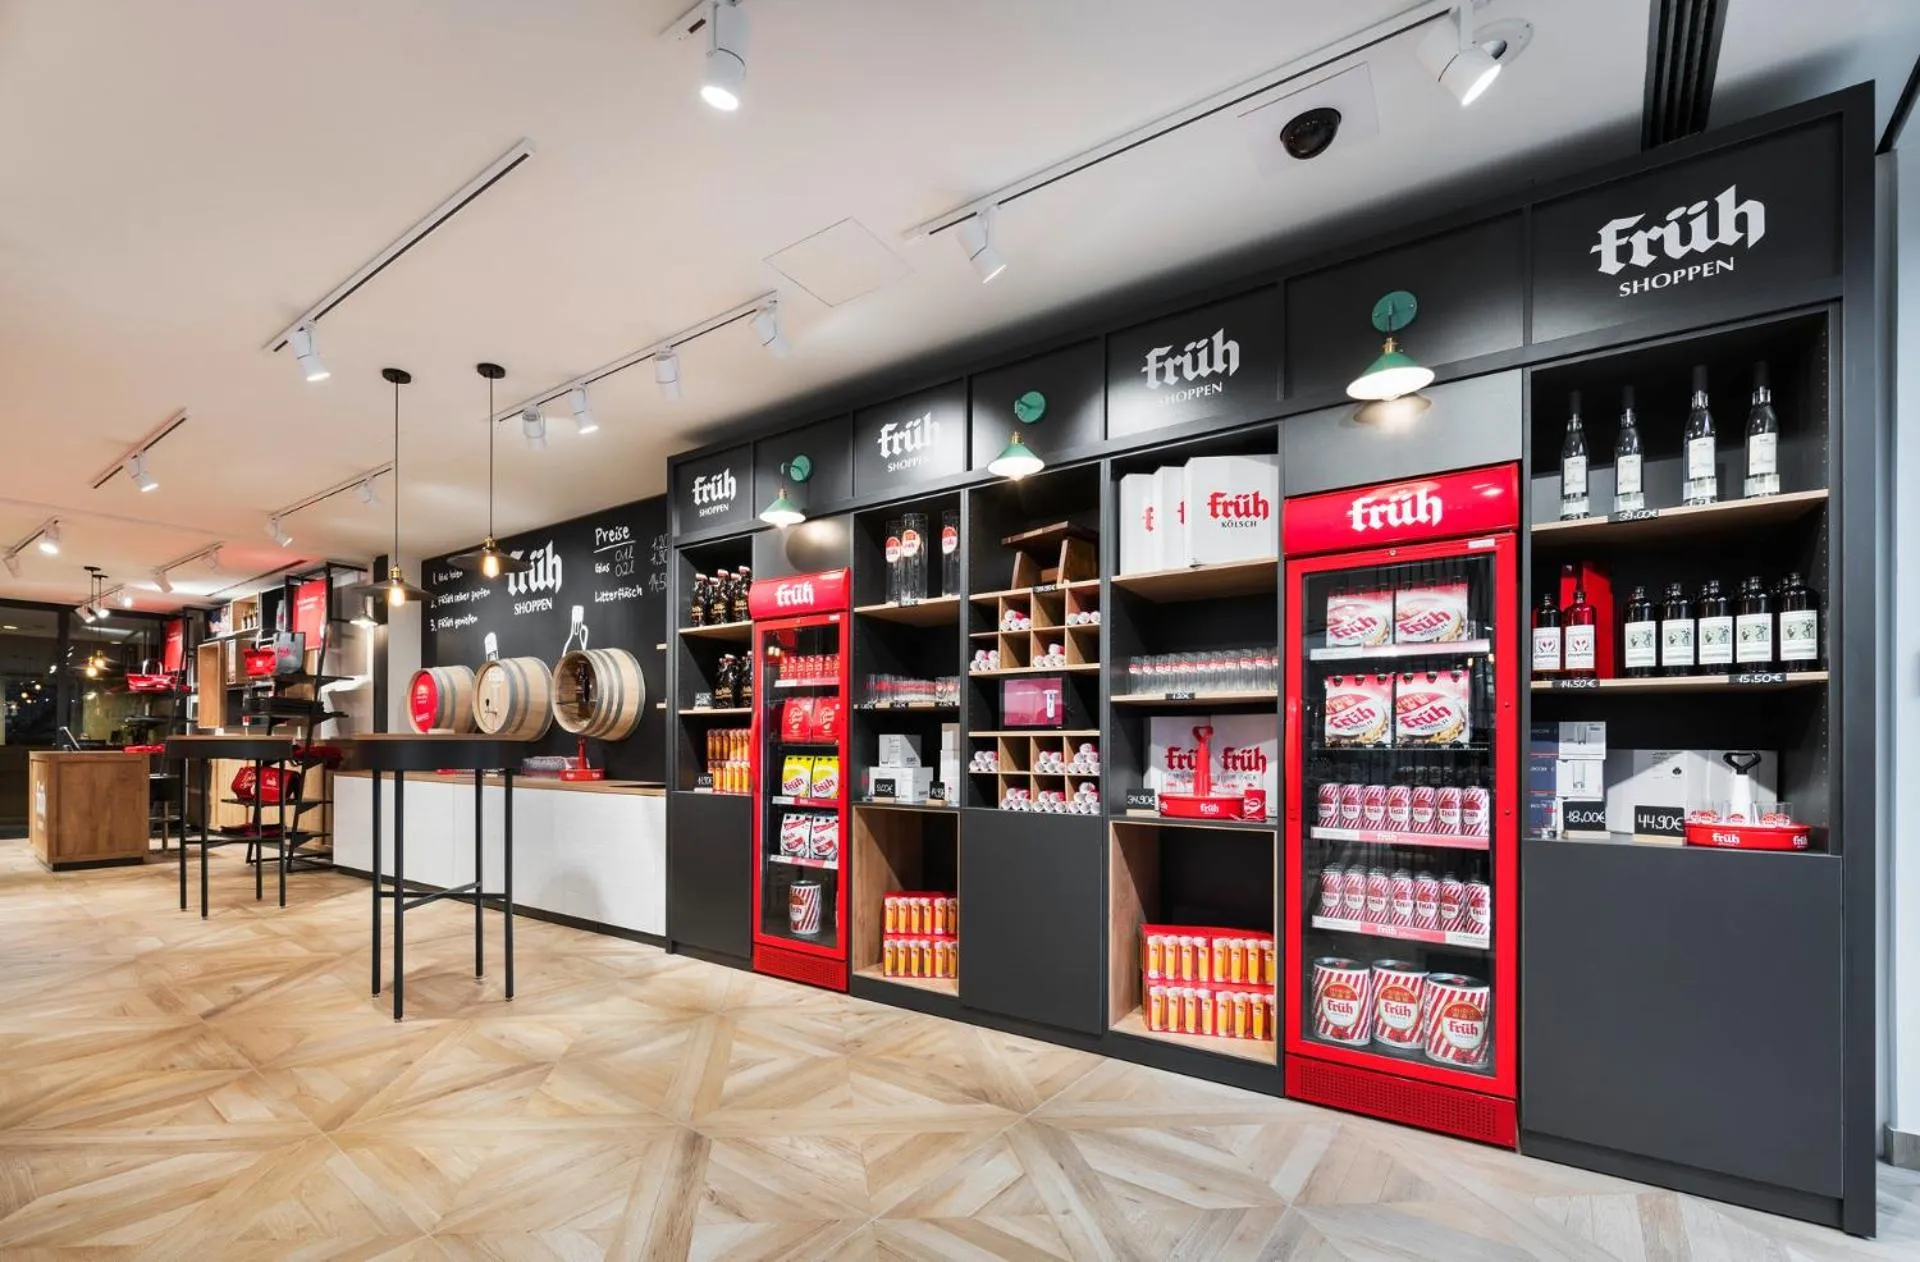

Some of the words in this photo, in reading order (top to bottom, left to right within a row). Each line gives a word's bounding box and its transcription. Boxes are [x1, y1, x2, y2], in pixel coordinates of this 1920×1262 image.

[1618, 255, 1735, 298] SHOPPEN
[1158, 381, 1223, 406] SHOPPEN
[699, 503, 730, 517] SHOPPEN
[1221, 519, 1257, 529] KÖLSCH
[595, 526, 630, 546] Preise
[513, 597, 553, 616] SHOPPEN
[1164, 746, 1198, 770] frü
